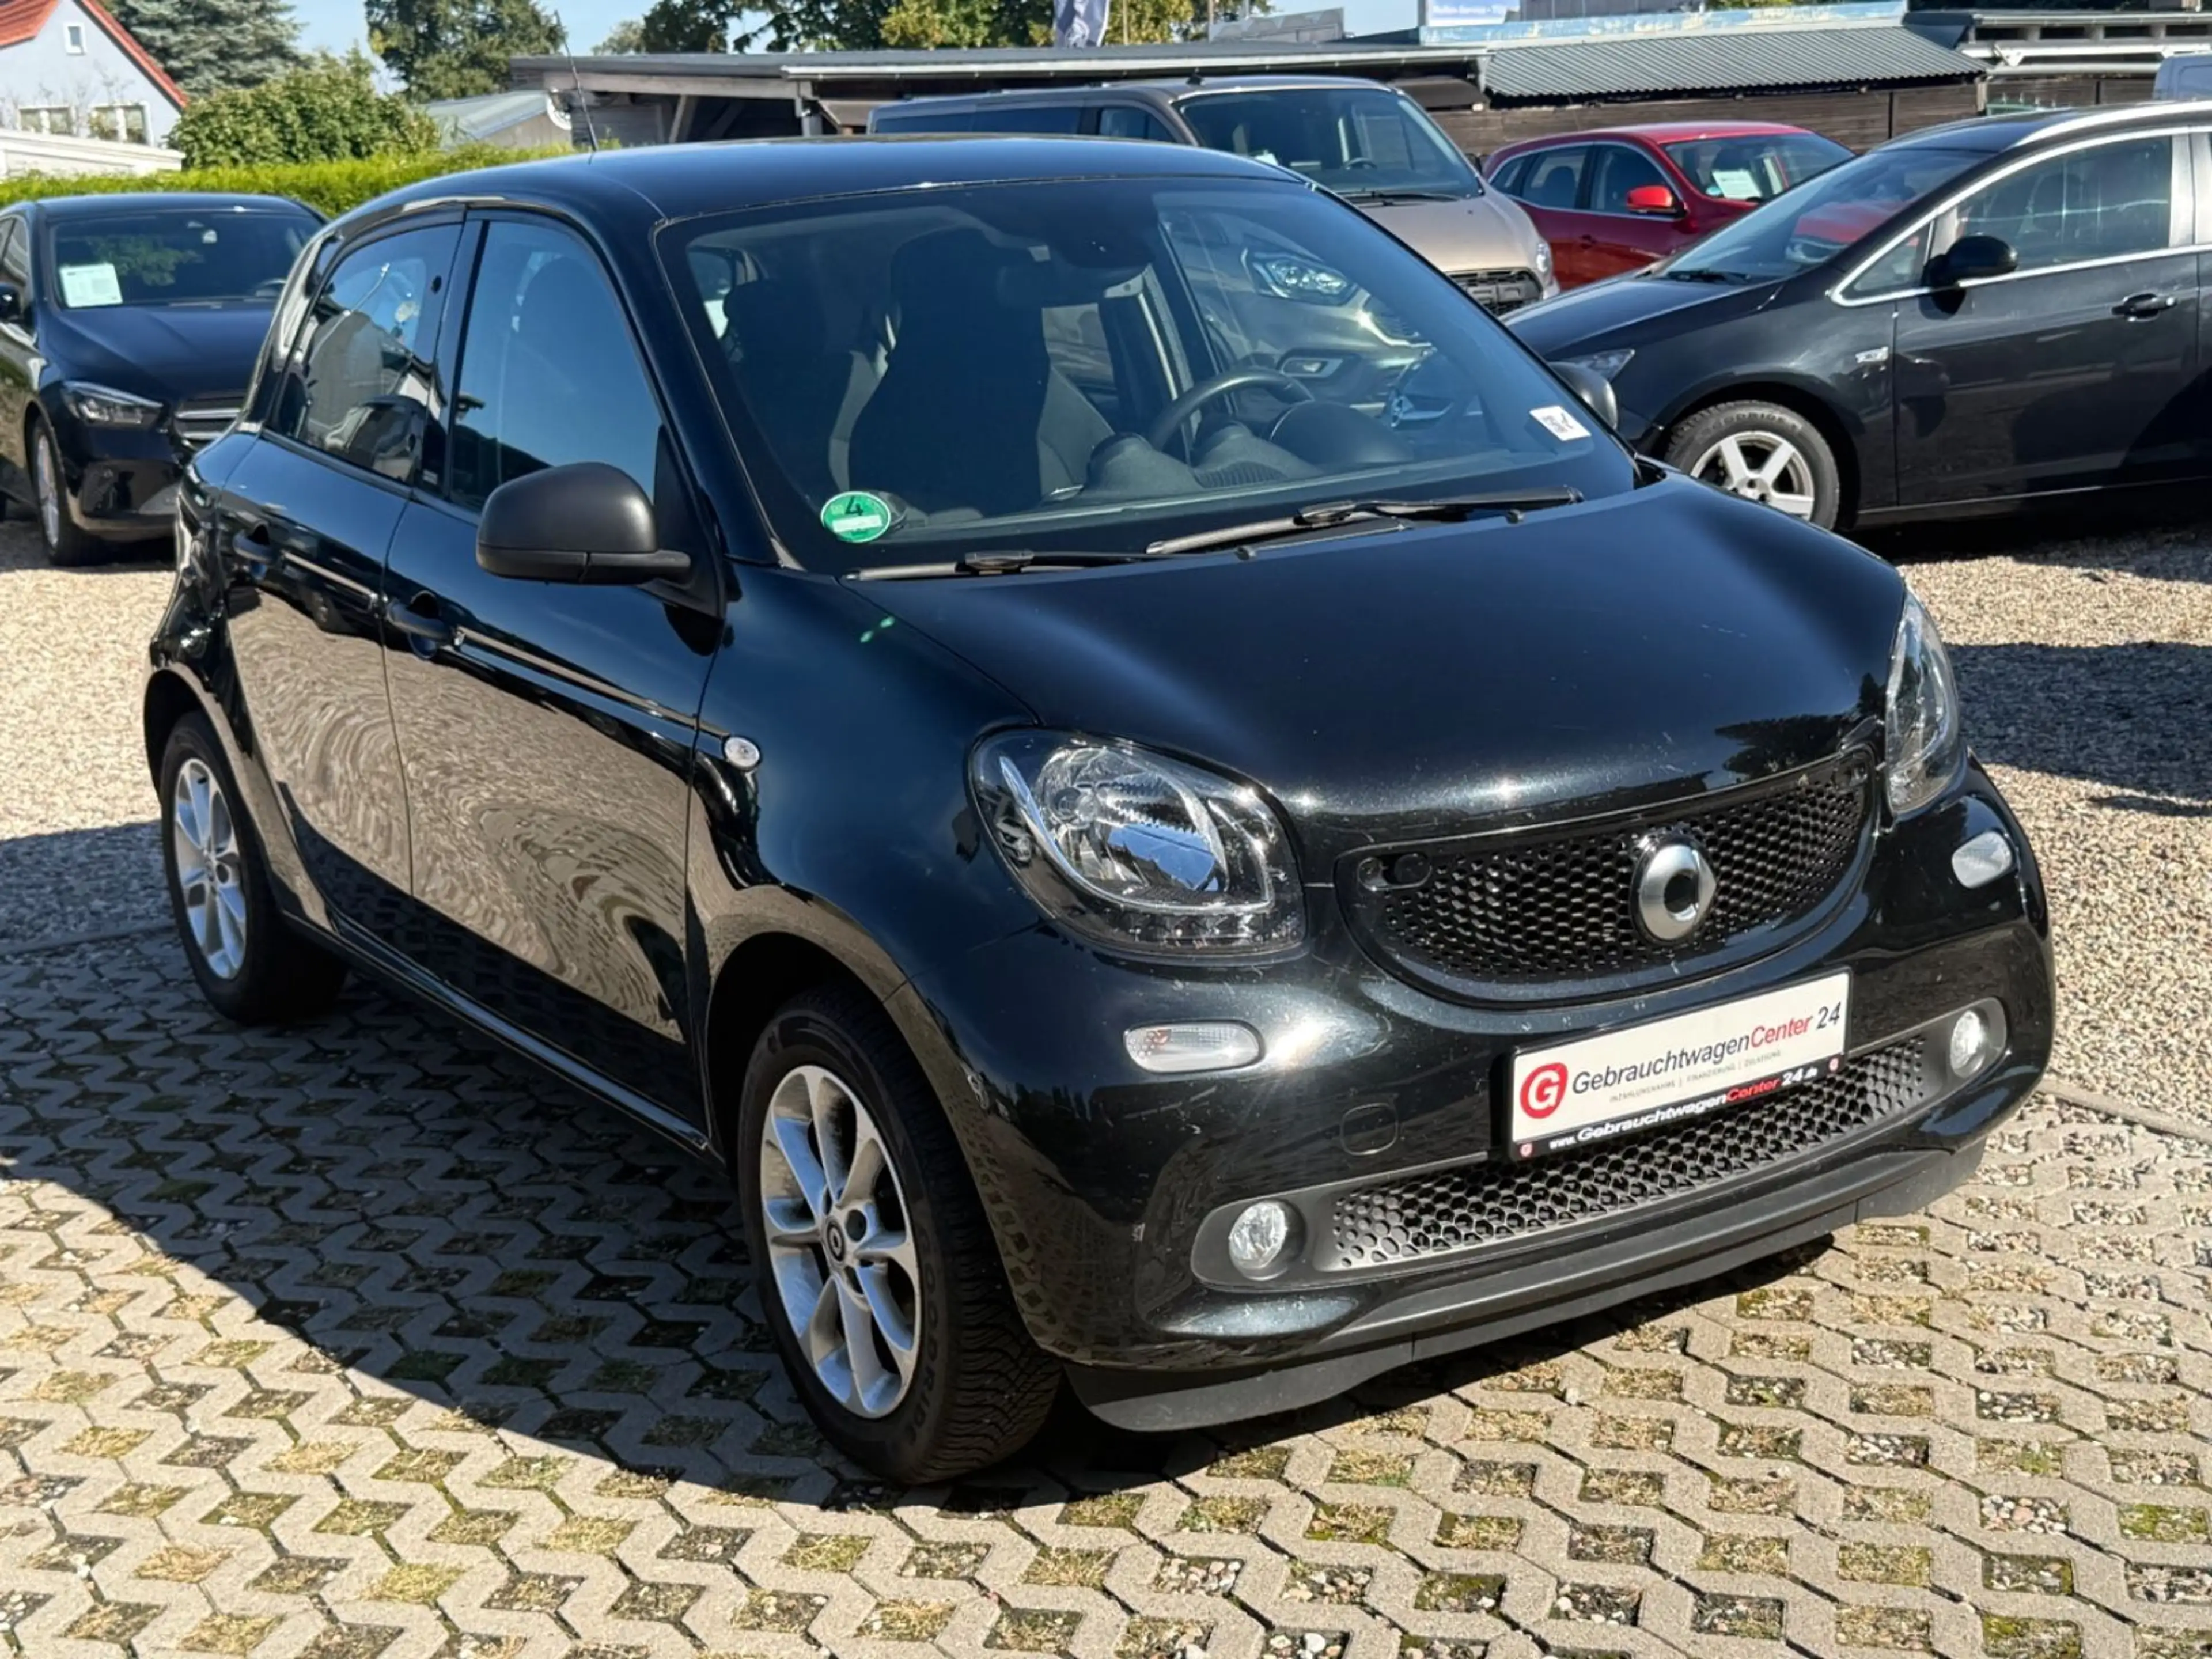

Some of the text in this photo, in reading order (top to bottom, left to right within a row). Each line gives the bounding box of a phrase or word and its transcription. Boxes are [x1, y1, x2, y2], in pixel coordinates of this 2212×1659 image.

[845, 495, 863, 516] 4
[1525, 1001, 1842, 1112] G GebrauchtwagenCenter 24
